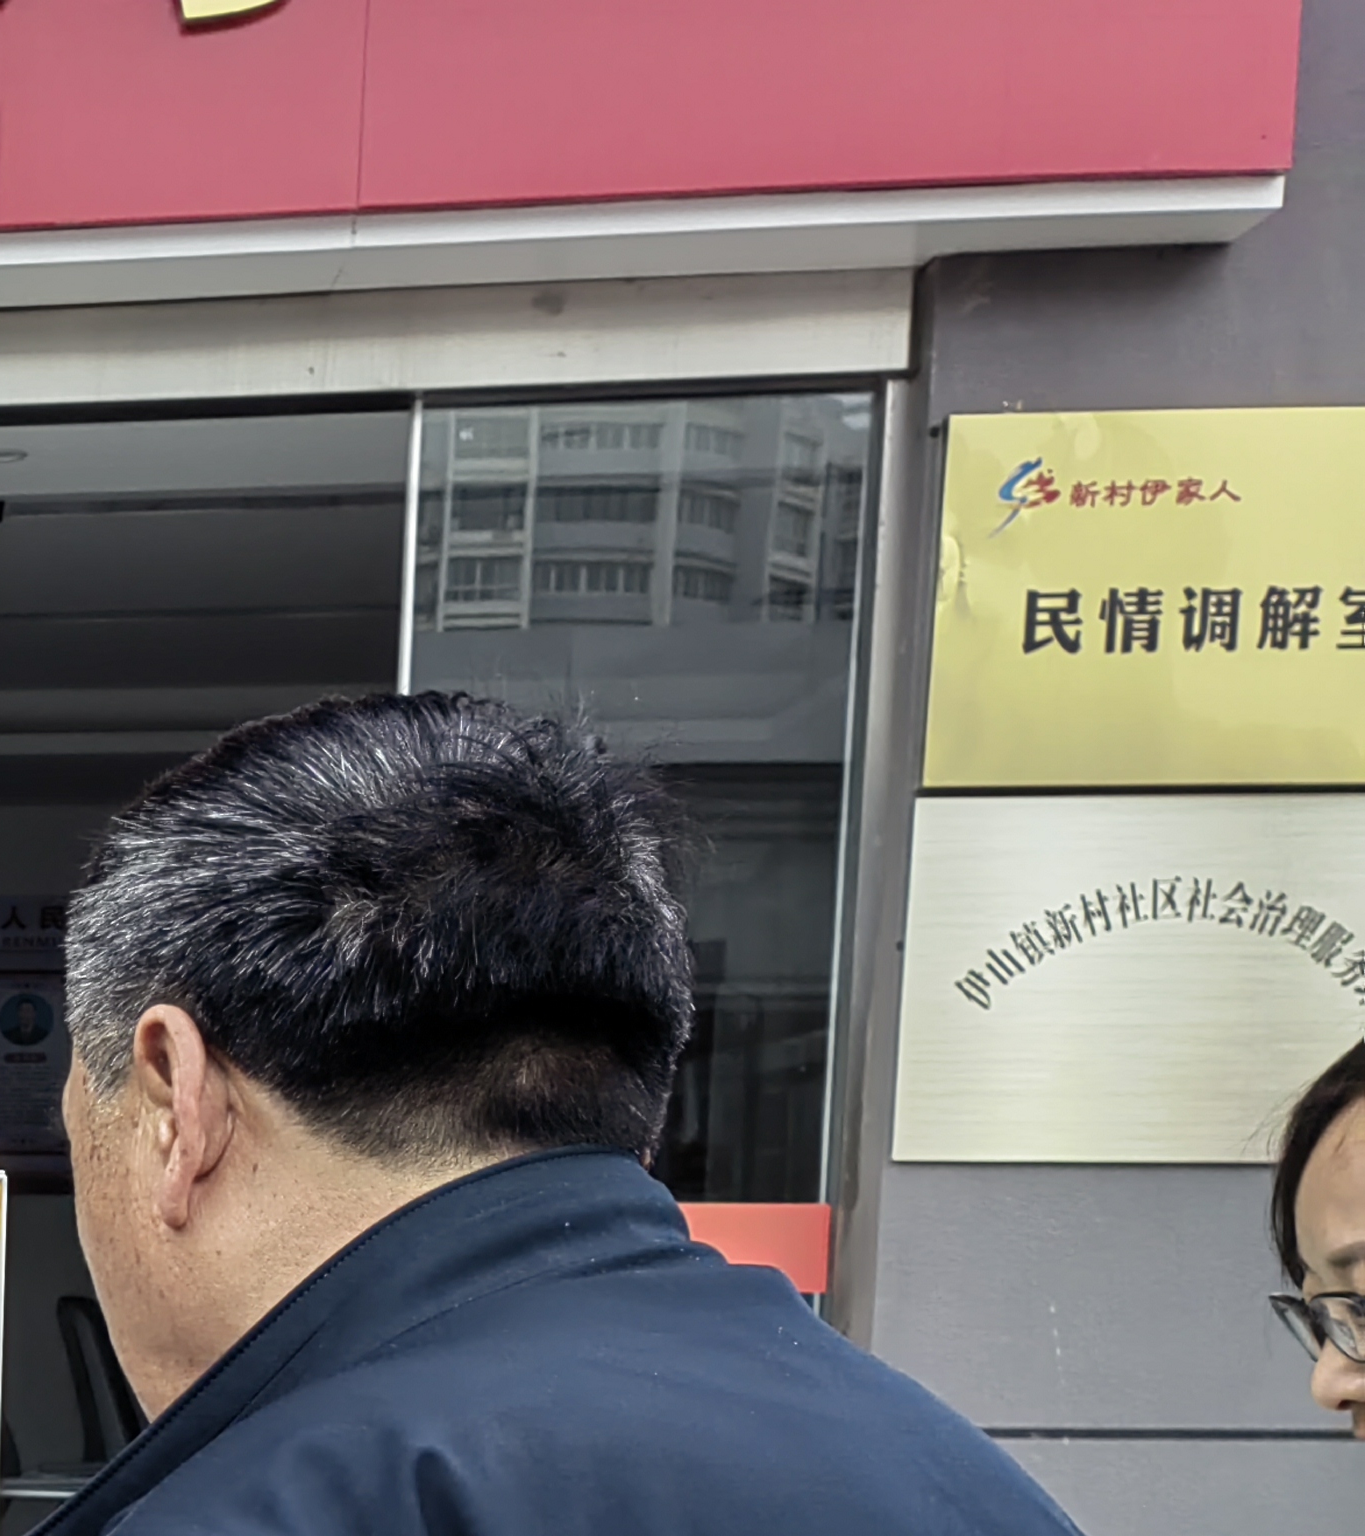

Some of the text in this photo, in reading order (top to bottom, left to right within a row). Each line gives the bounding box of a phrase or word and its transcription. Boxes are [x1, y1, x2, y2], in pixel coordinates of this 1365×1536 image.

[1069, 477, 1242, 508] 新村伊家人
[954, 876, 1365, 1010] 伊山镇新村社区社会治理服务
